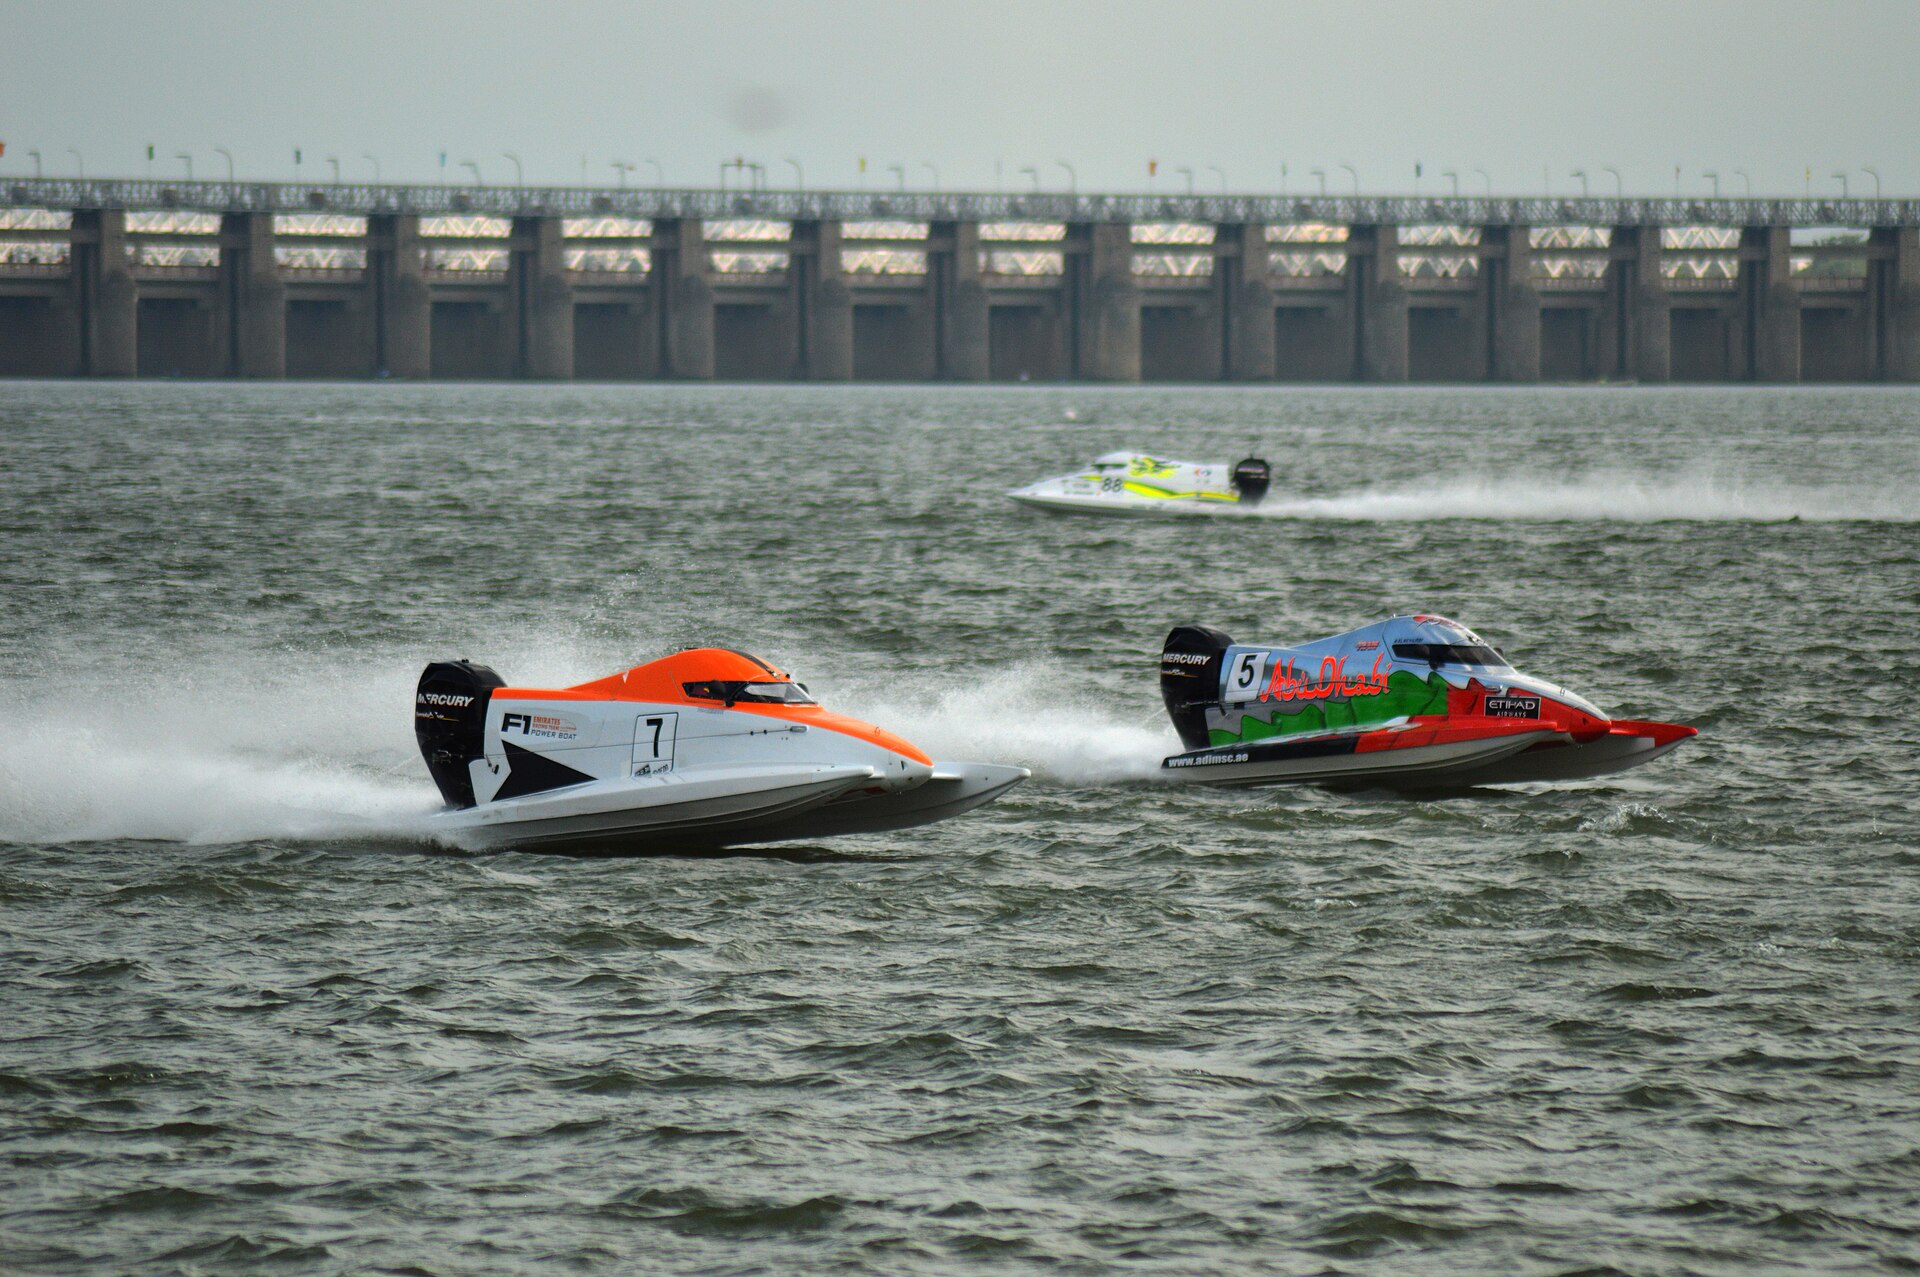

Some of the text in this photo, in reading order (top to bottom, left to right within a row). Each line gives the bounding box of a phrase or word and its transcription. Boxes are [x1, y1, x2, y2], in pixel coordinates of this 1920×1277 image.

[1102, 477, 1123, 492] 88
[1162, 653, 1211, 666] MERCURY
[1238, 654, 1258, 688] 5
[1260, 655, 1318, 702] Abu
[1489, 700, 1536, 710] ETIHAD
[501, 713, 532, 735] F1
[533, 715, 561, 725] EMIRATES
[530, 729, 577, 740] POWER BOAT
[646, 717, 664, 758] 7
[1168, 753, 1249, 768] www.adimsc.ae
